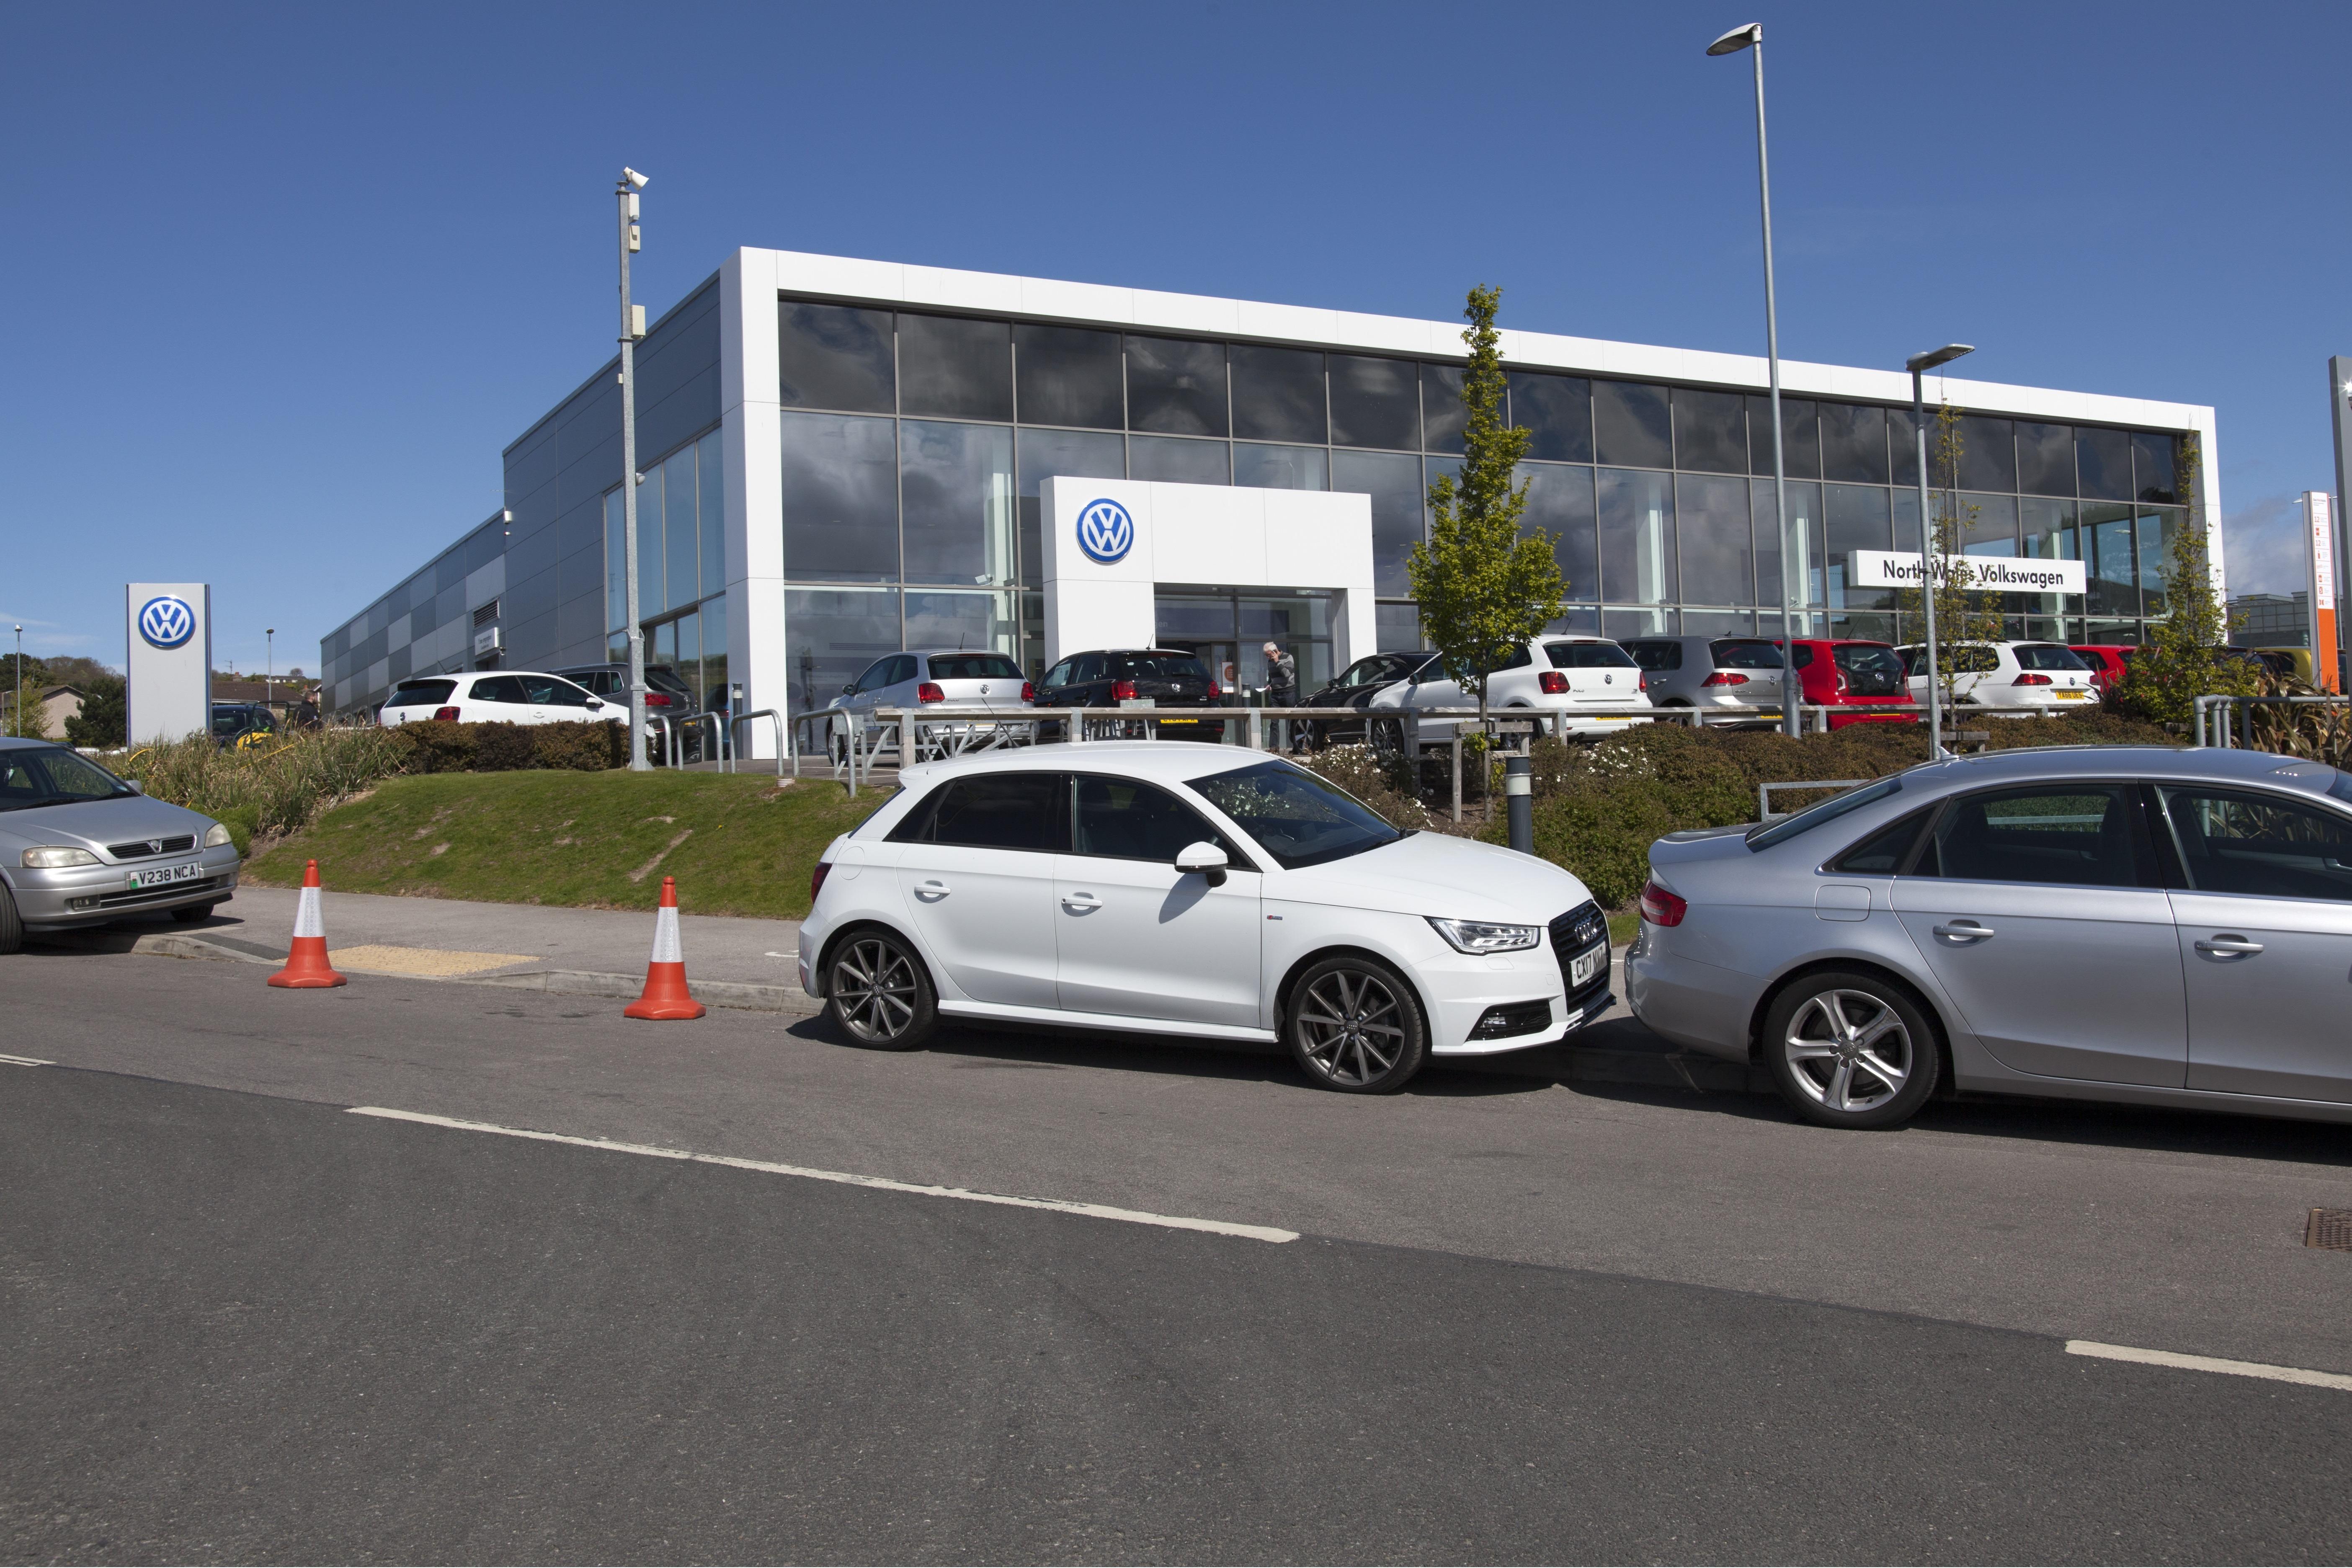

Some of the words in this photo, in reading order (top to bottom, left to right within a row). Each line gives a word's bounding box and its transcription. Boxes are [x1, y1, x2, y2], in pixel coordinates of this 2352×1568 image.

[1082, 503, 1130, 557] VW
[1979, 564, 2063, 589] Volkswagen
[143, 600, 190, 642] VW
[139, 869, 171, 885] V238
[174, 865, 196, 879] NCA
[1576, 954, 1591, 979] CX17
